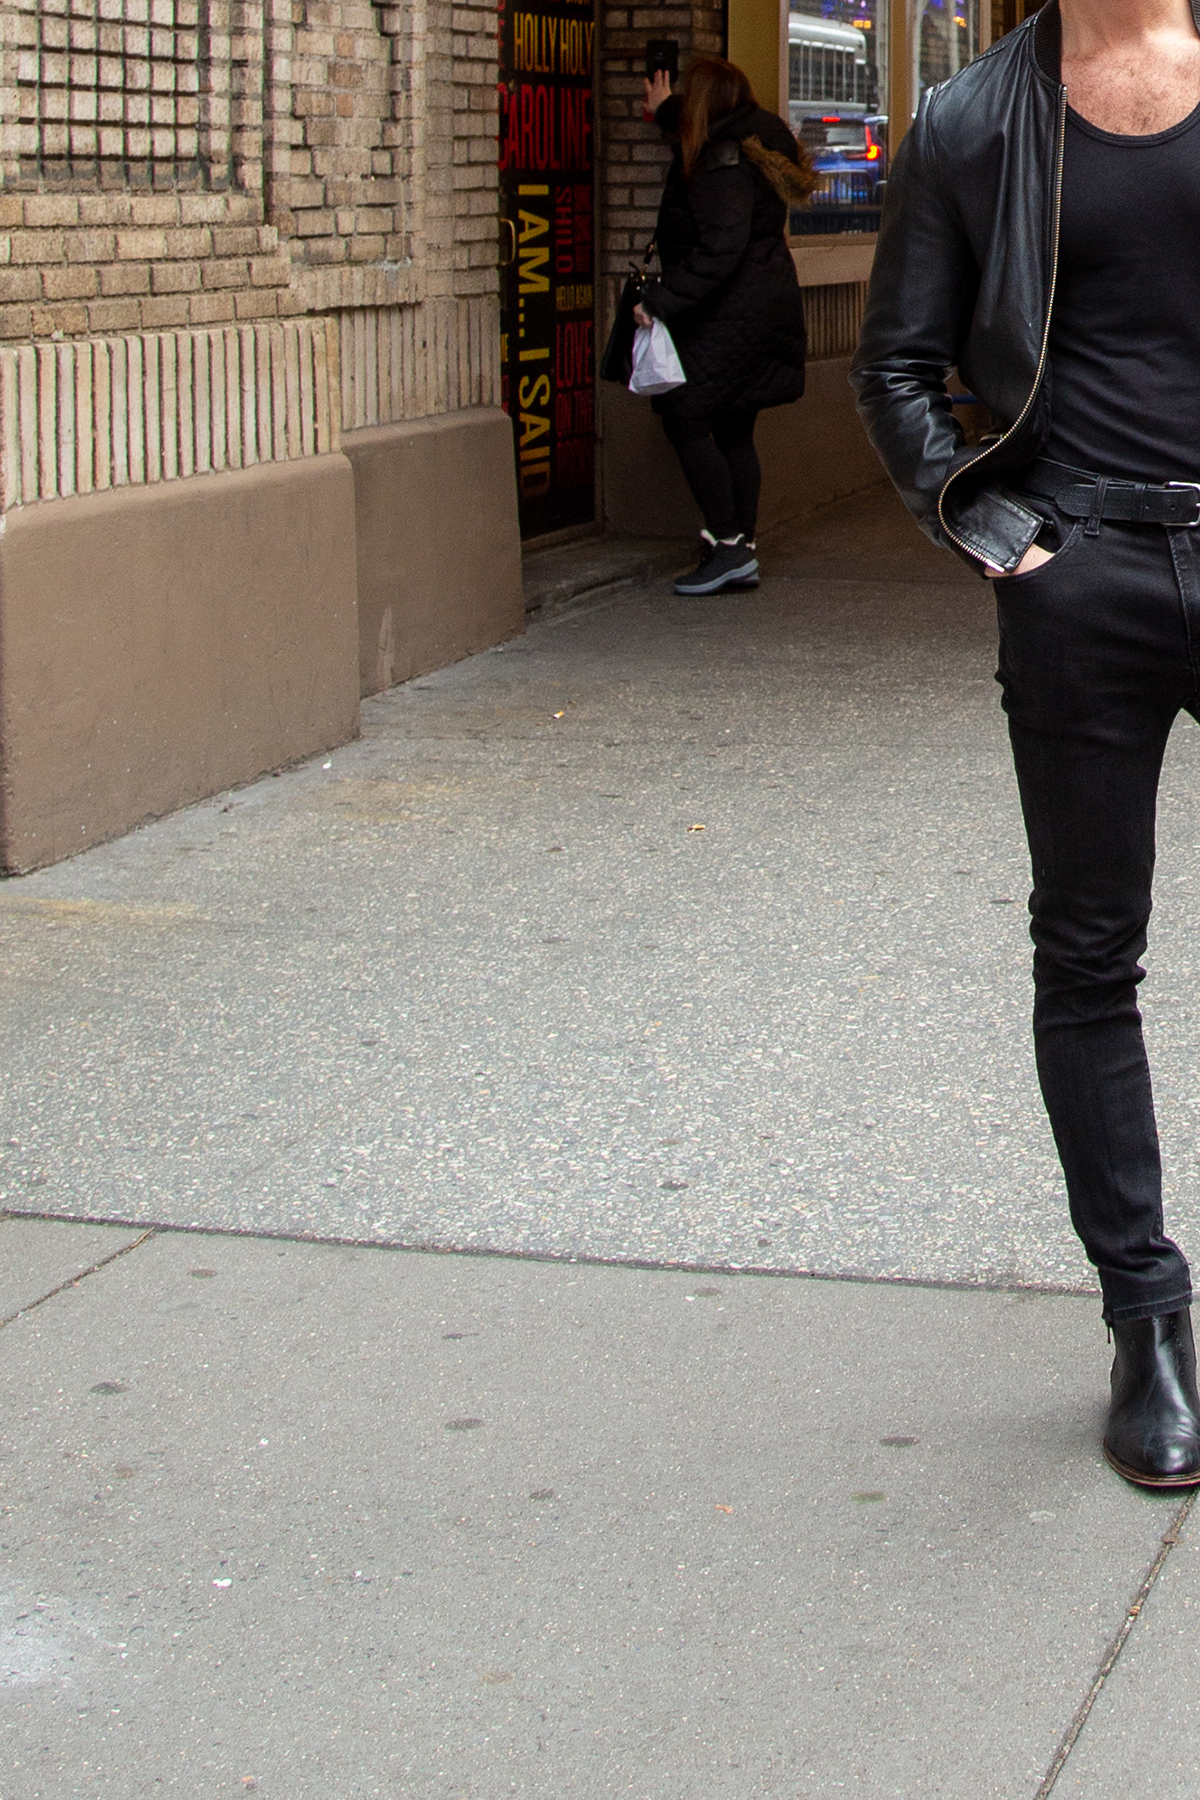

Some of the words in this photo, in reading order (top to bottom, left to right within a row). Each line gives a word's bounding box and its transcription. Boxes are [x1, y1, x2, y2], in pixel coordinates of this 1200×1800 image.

[513, 11, 557, 74] HOLLY
[559, 17, 595, 76] HOLY
[517, 184, 550, 196] I
[518, 347, 551, 361] I
[518, 373, 551, 498] SAID
